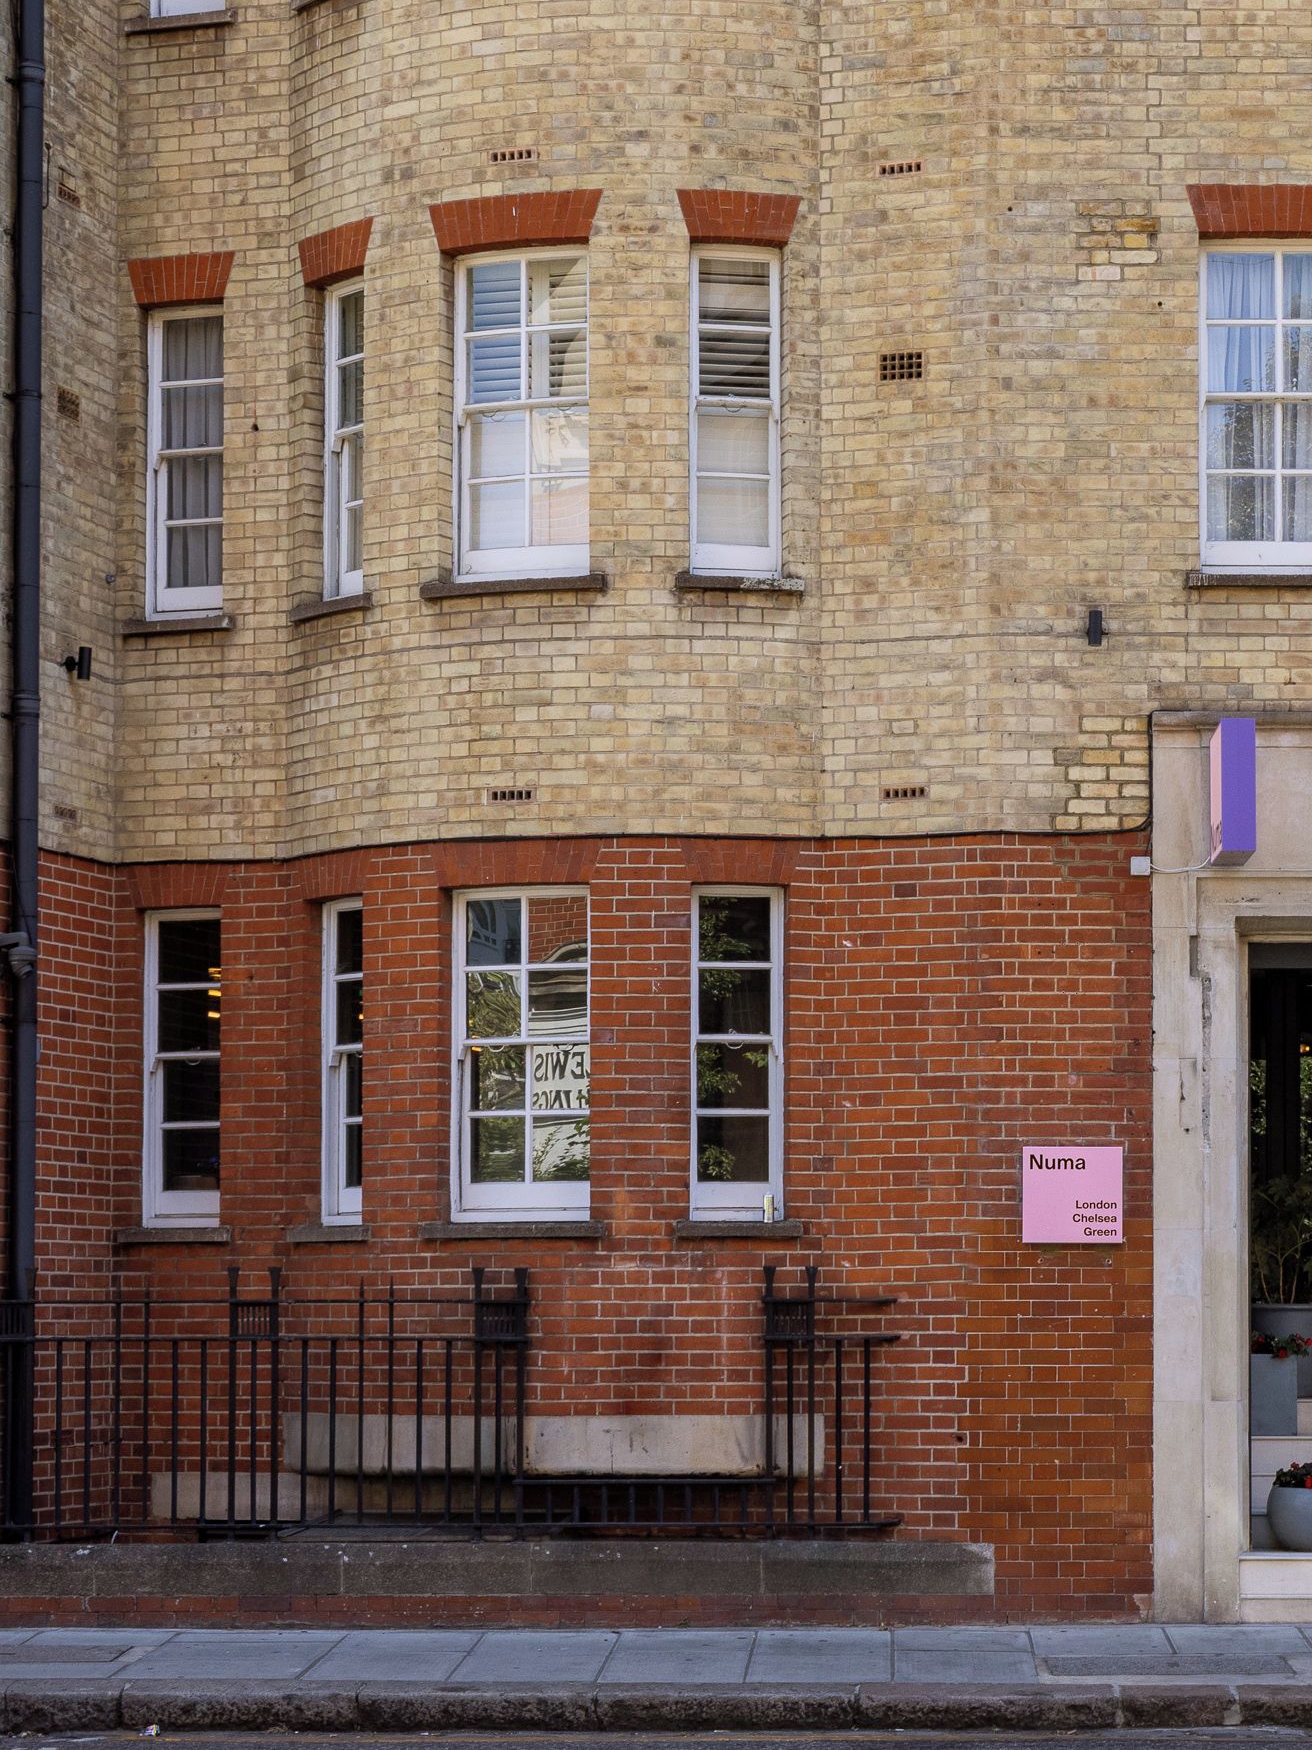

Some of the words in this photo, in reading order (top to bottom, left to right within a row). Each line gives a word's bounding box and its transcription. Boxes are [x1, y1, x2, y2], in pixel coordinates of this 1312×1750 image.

[1029, 1154, 1086, 1170] Numa
[1075, 1200, 1118, 1210] London
[1072, 1213, 1118, 1223] Chelsea
[1083, 1227, 1118, 1237] Green
